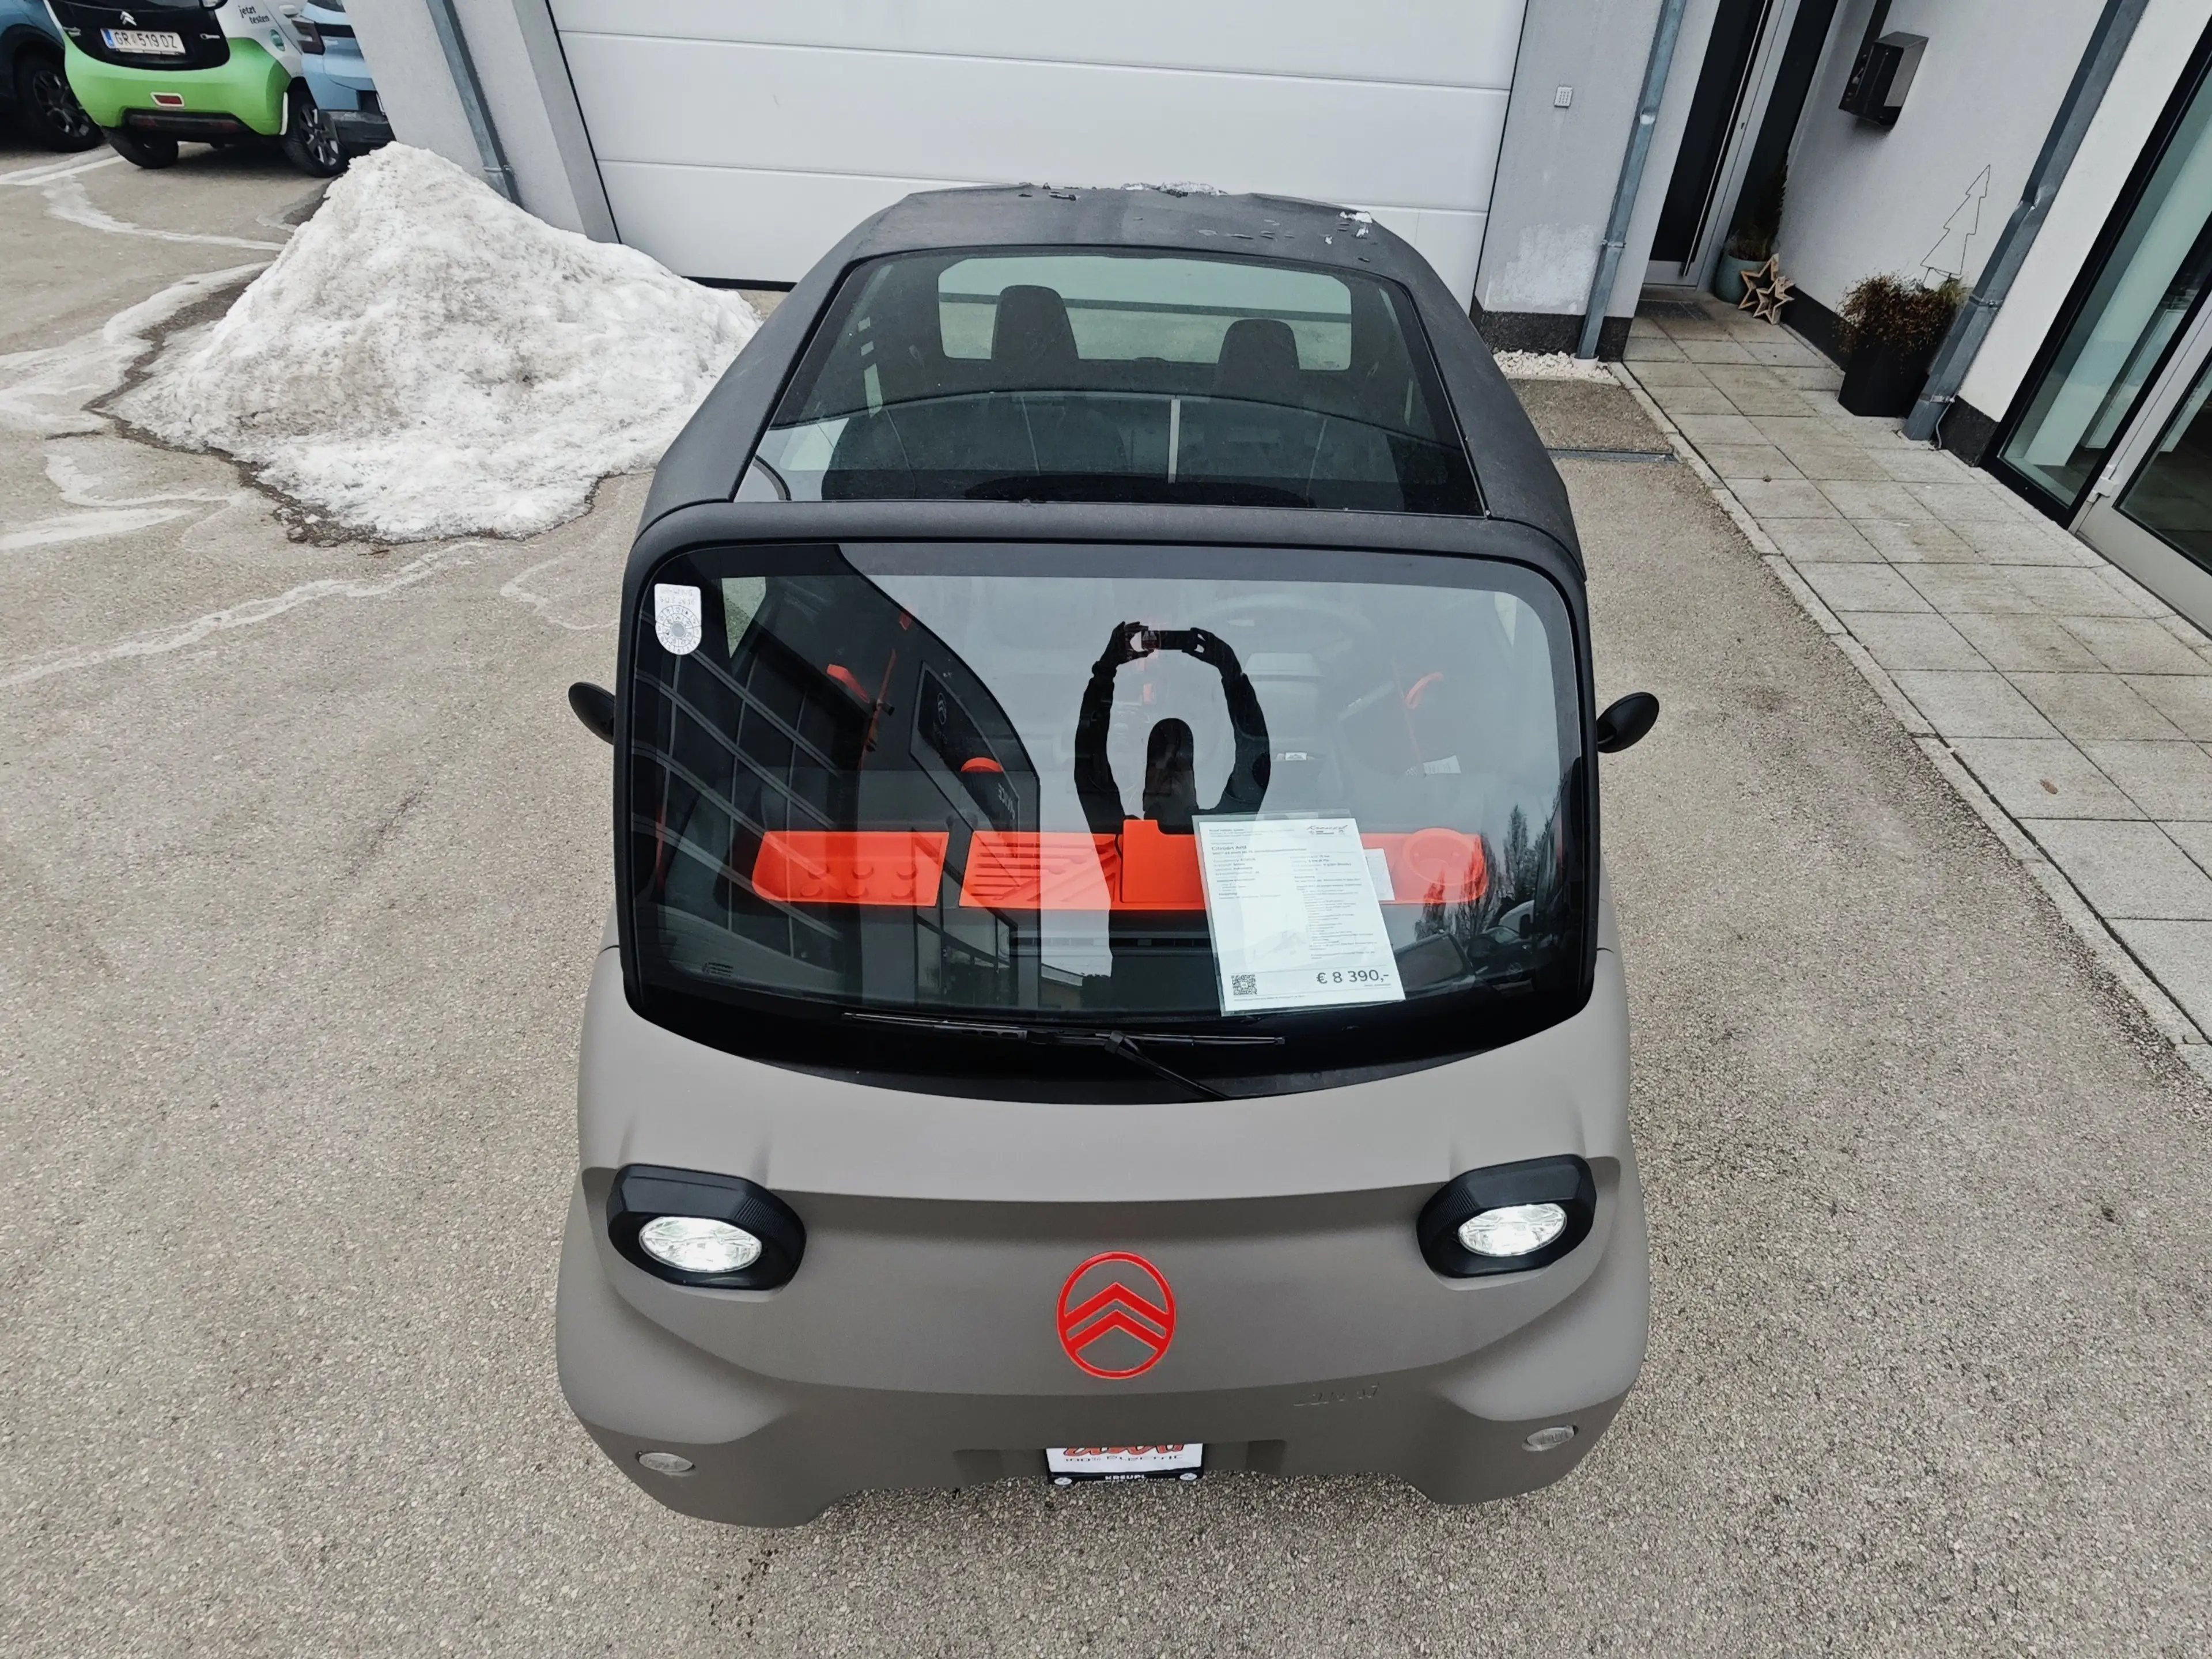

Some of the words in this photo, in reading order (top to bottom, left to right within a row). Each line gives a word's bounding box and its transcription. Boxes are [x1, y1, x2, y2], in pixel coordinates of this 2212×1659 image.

[238, 5, 256, 18] jetzt
[249, 14, 270, 24] testen
[115, 32, 131, 45] GR
[1316, 972, 1328, 984] €
[1332, 971, 1343, 983] 8
[1348, 969, 1389, 982] 390,-
